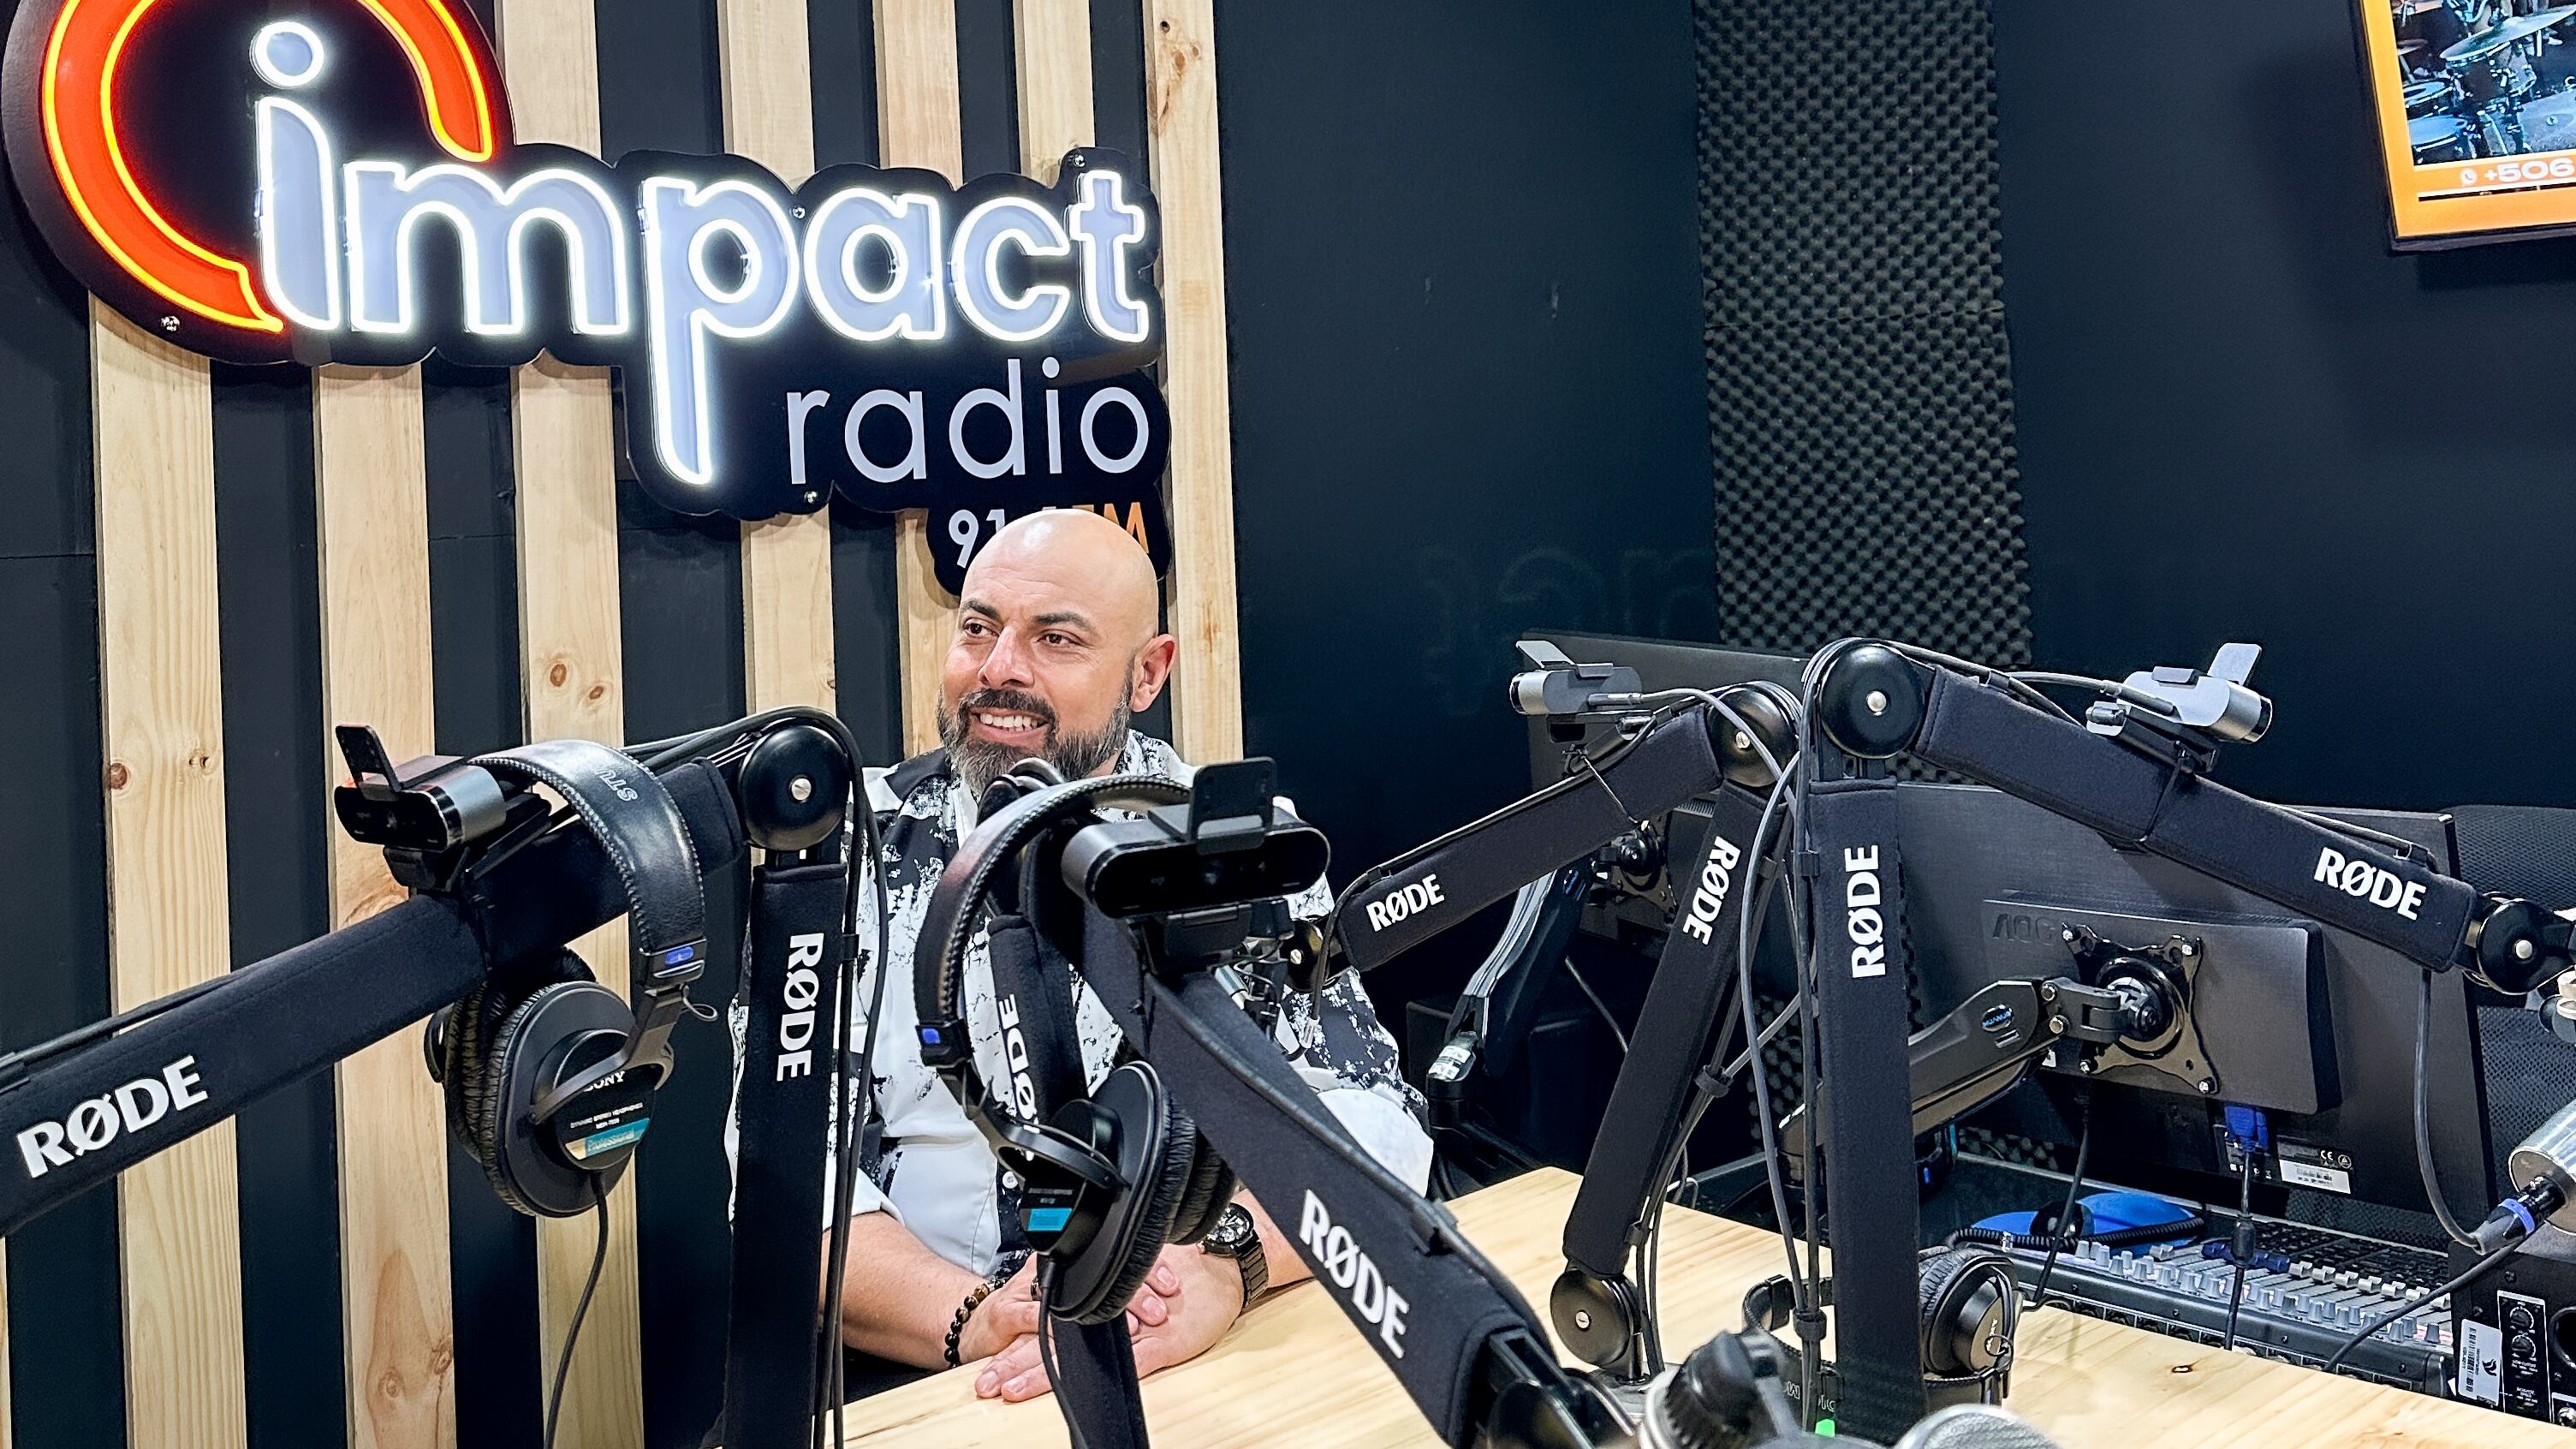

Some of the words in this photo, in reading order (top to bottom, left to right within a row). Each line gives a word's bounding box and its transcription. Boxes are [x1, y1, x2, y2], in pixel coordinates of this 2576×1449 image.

[2484, 158, 2575, 182] +506
[248, 19, 1151, 486] impact
[785, 356, 1150, 485] radio
[1365, 874, 1445, 932] RØDE
[1683, 836, 1741, 945] RØDE
[1844, 844, 1886, 978] RØDE
[2313, 846, 2427, 921] RØDE
[776, 933, 824, 1082] RØDE
[16, 1054, 208, 1178] RØDE
[998, 993, 1039, 1161] ØDE
[1299, 1188, 1410, 1360] RØDE
